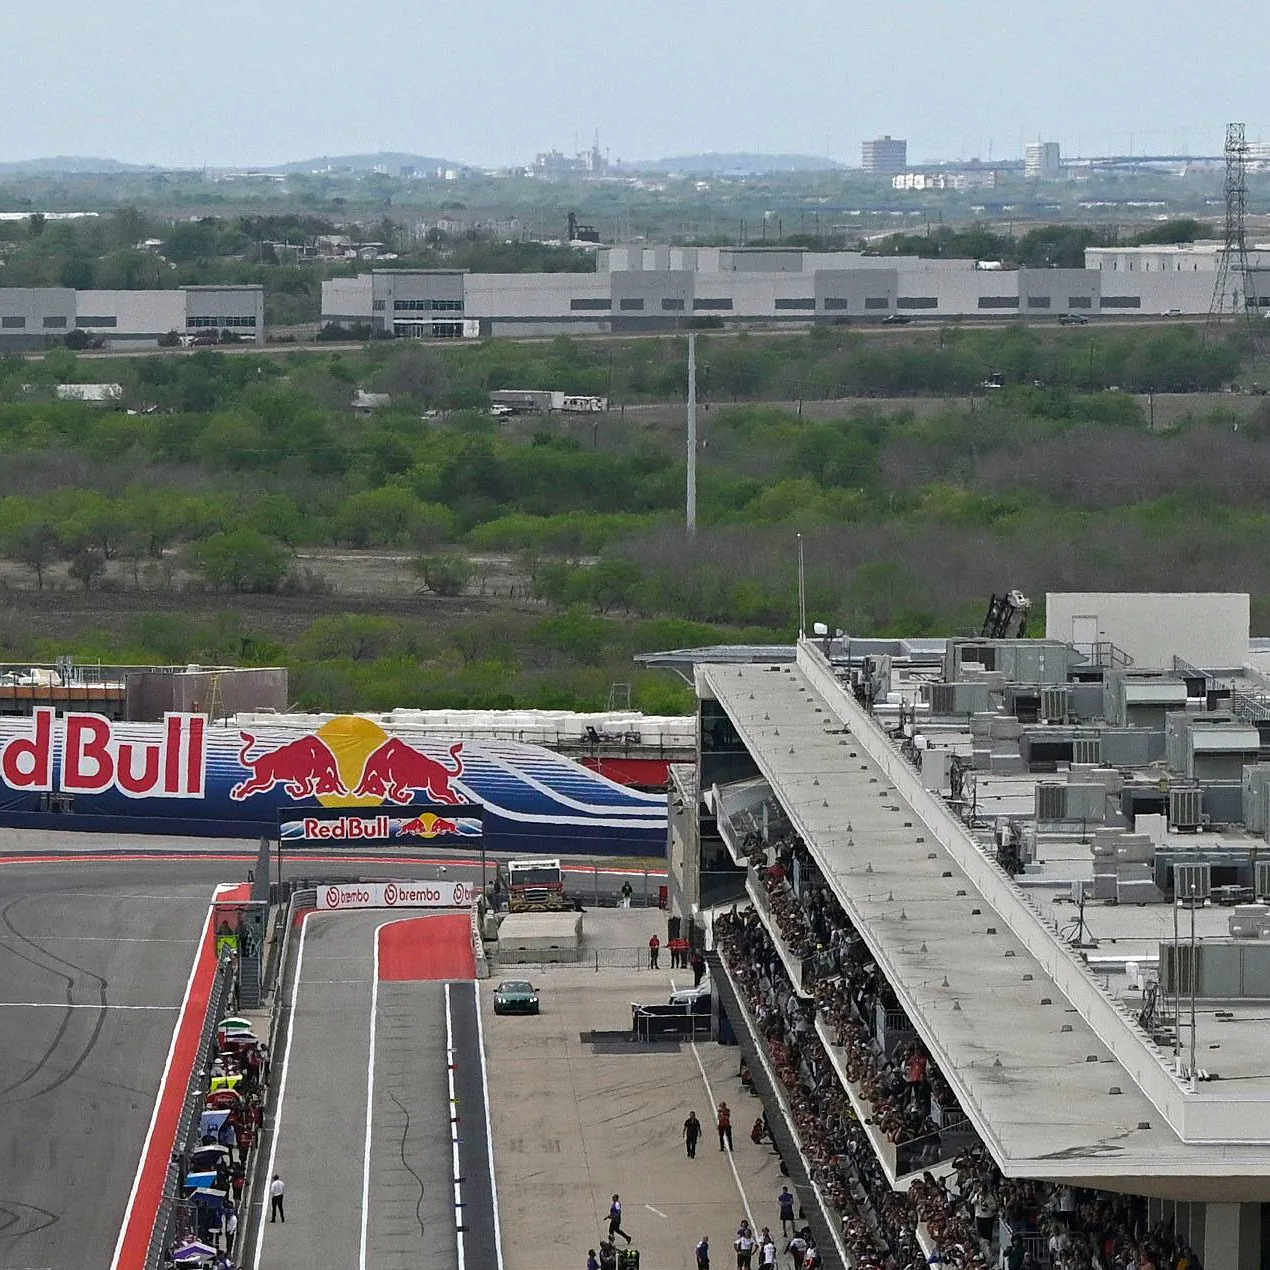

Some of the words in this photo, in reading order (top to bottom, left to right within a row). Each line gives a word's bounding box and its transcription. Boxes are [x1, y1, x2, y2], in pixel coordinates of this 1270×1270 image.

[62, 712, 206, 797] Bull
[304, 817, 344, 838] Red
[348, 816, 389, 838] Bull
[341, 889, 369, 903] brembo
[399, 887, 440, 901] brembo
